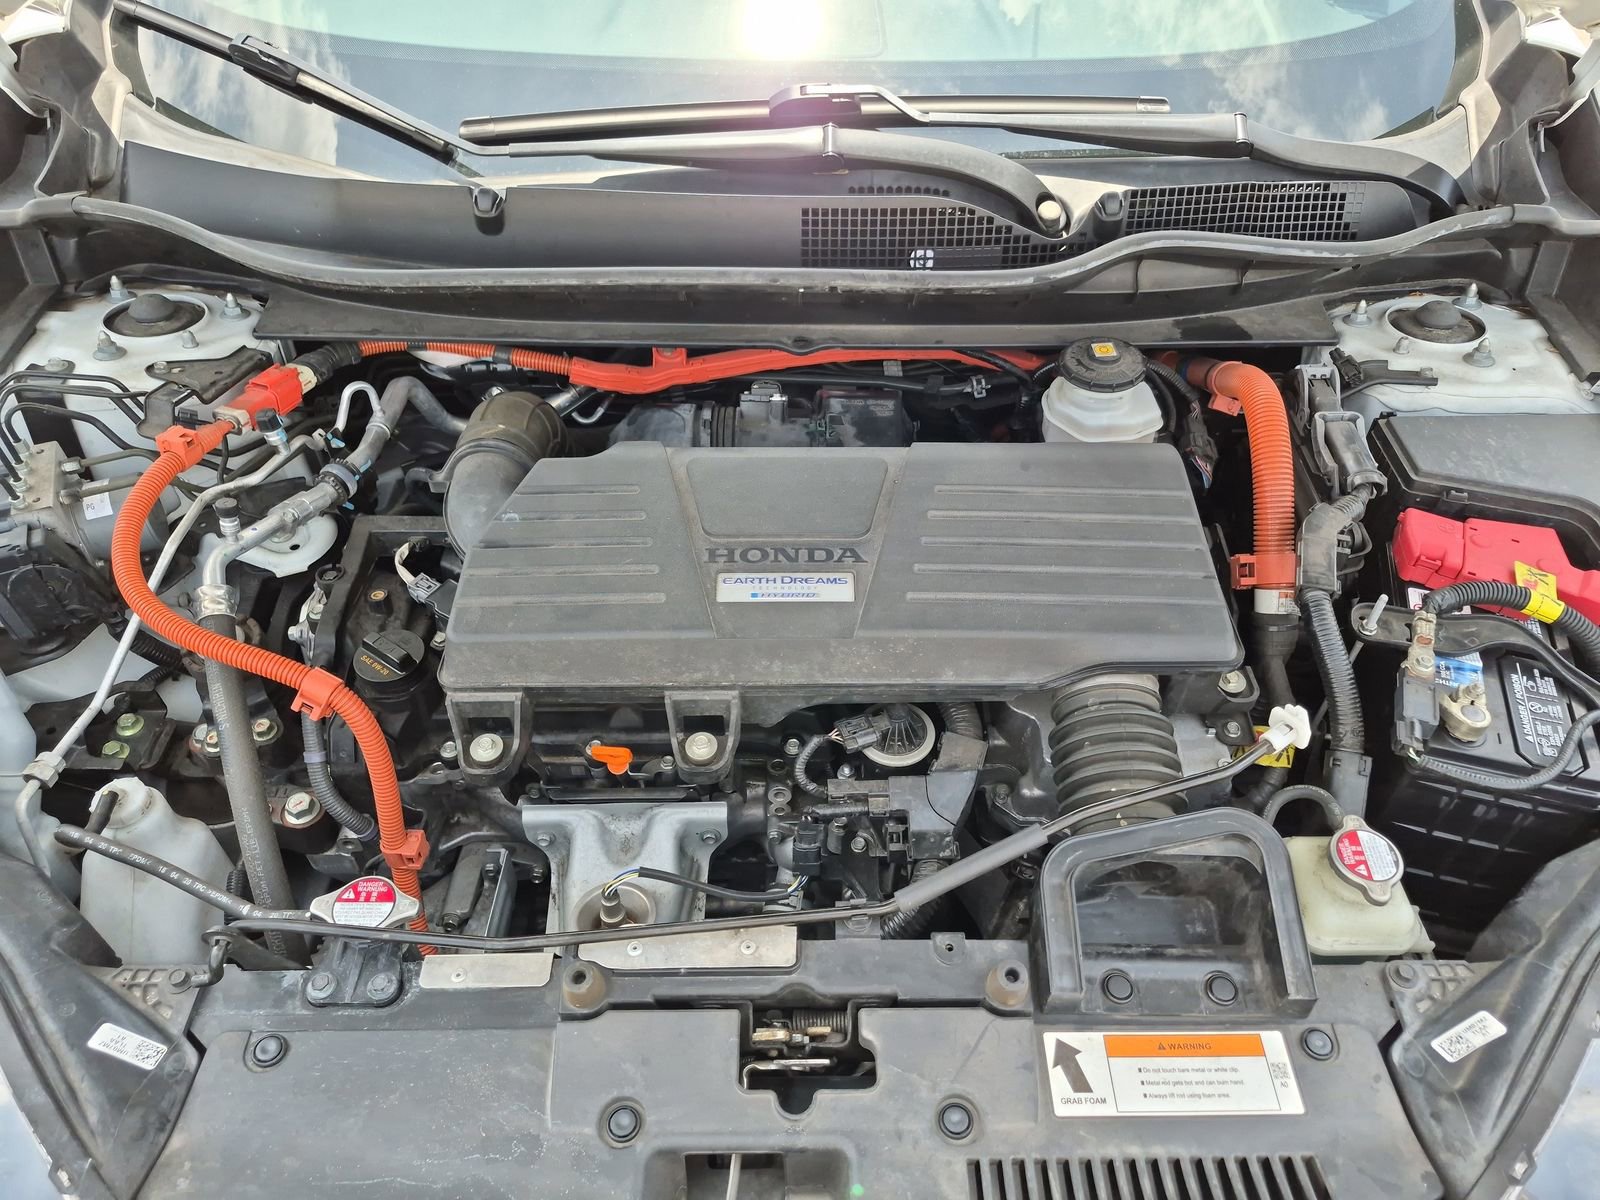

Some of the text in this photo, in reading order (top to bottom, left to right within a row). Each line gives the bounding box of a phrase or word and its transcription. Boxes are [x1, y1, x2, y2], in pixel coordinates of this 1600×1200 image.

[704, 547, 868, 564] HONDA
[781, 576, 848, 585] DREAMS
[360, 655, 373, 664] SAE
[1510, 673, 1523, 699] POISON
[1518, 704, 1533, 738] DANGER
[193, 881, 206, 892] TPC
